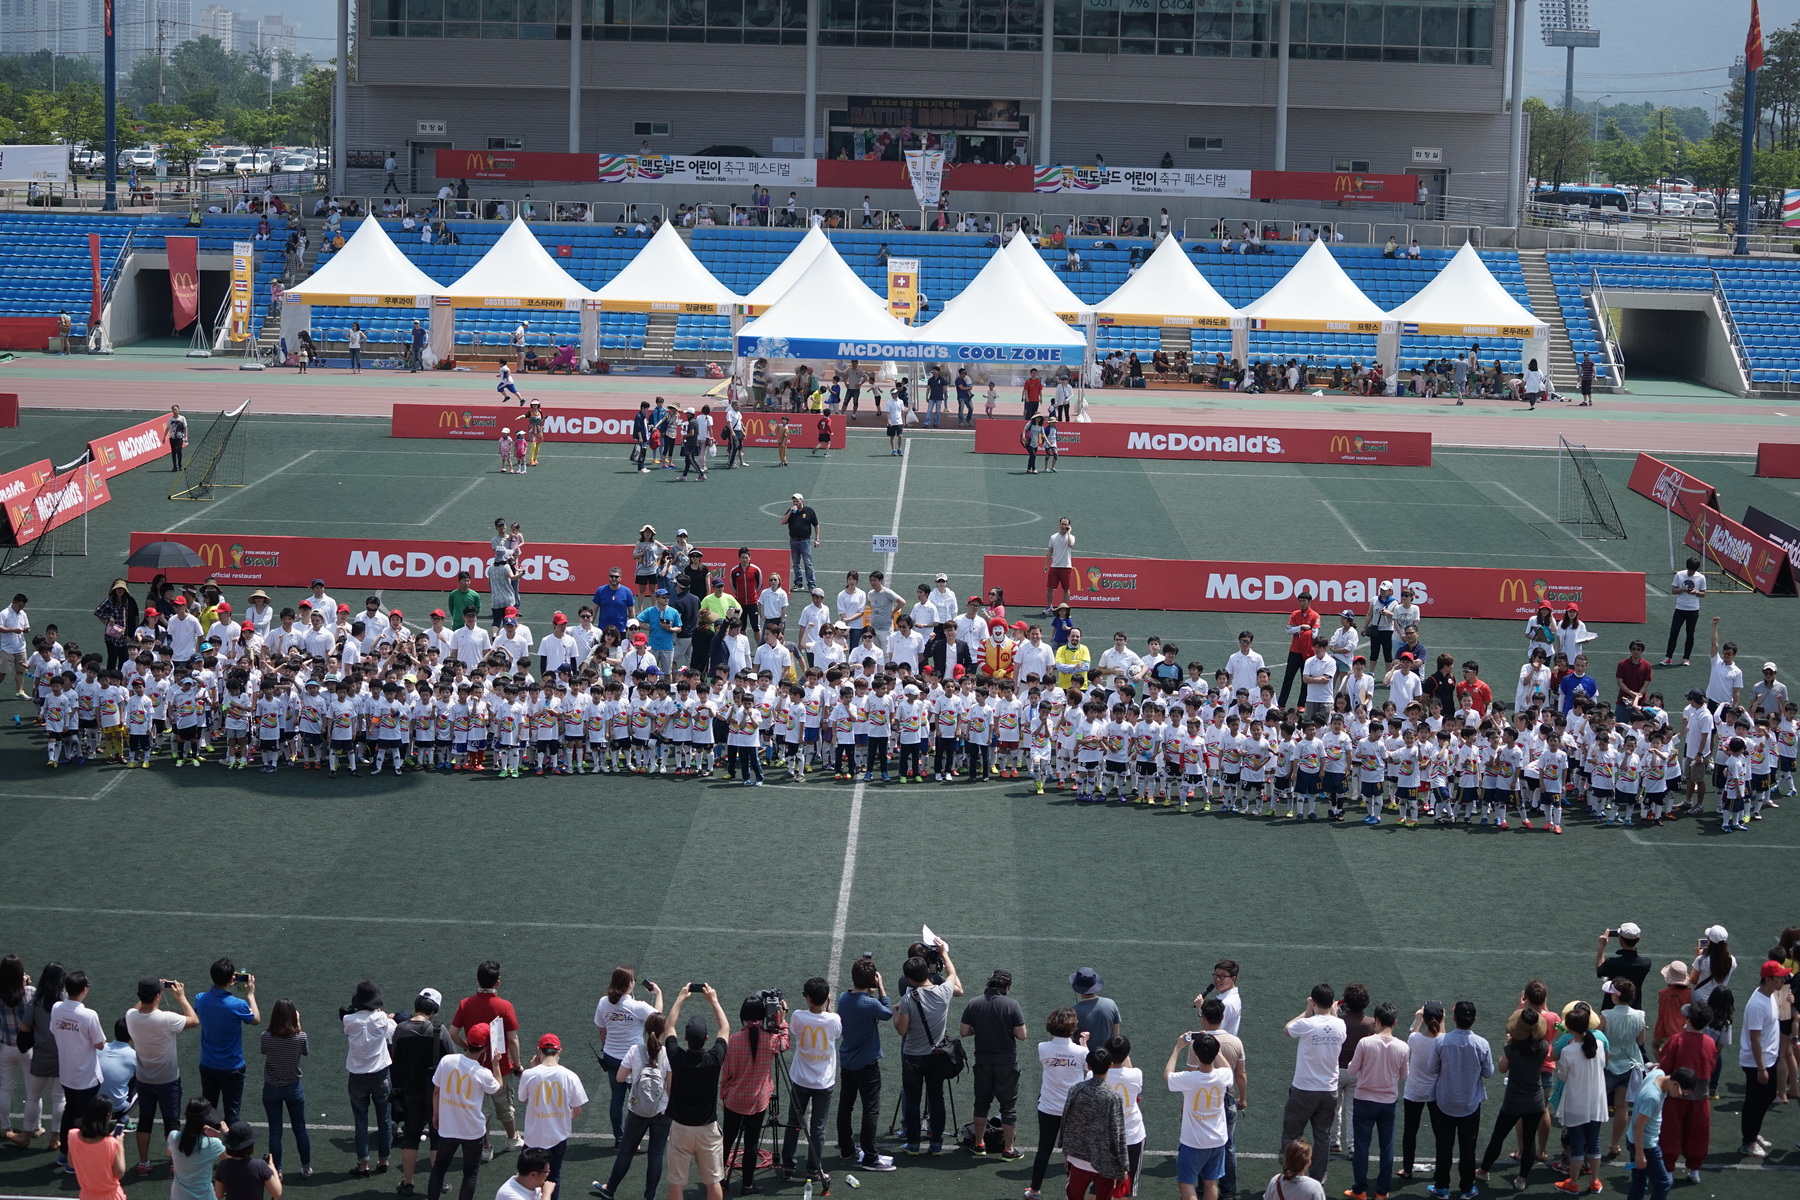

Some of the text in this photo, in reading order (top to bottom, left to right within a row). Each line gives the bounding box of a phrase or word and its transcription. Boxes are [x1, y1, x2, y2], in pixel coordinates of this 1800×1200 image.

[1128, 0, 1150, 8] 796
[1159, 0, 1193, 10] 0404
[641, 159, 790, 177] 맥도날드 어린이 축구 페스티벌
[1077, 169, 1227, 188] 맥도날드 어린이 축구 페스티벌
[349, 296, 379, 304] URUGUAY
[384, 296, 413, 305] 우루과이
[484, 298, 505, 306] COSTA
[527, 299, 563, 307] 코스타리카
[685, 304, 714, 312] 잉글랜드
[1327, 322, 1350, 330] FRANCE
[1357, 323, 1379, 331] 프랑스
[1463, 326, 1498, 334] HONDURAS
[1502, 327, 1531, 335] 온두라스
[838, 342, 1062, 362] McDonald's COOL ZONE
[471, 419, 497, 428] Brasil
[118, 429, 162, 462] McDonald's
[1127, 432, 1281, 454] McDonald's
[1363, 444, 1388, 452] Brasil
[879, 538, 898, 547] 경기장
[244, 556, 280, 568] Brasil
[346, 550, 570, 581] McDond's
[1101, 578, 1137, 590] Brasil
[1547, 591, 1583, 602] Brasil
[1053, 1057, 1077, 1067] 2014
